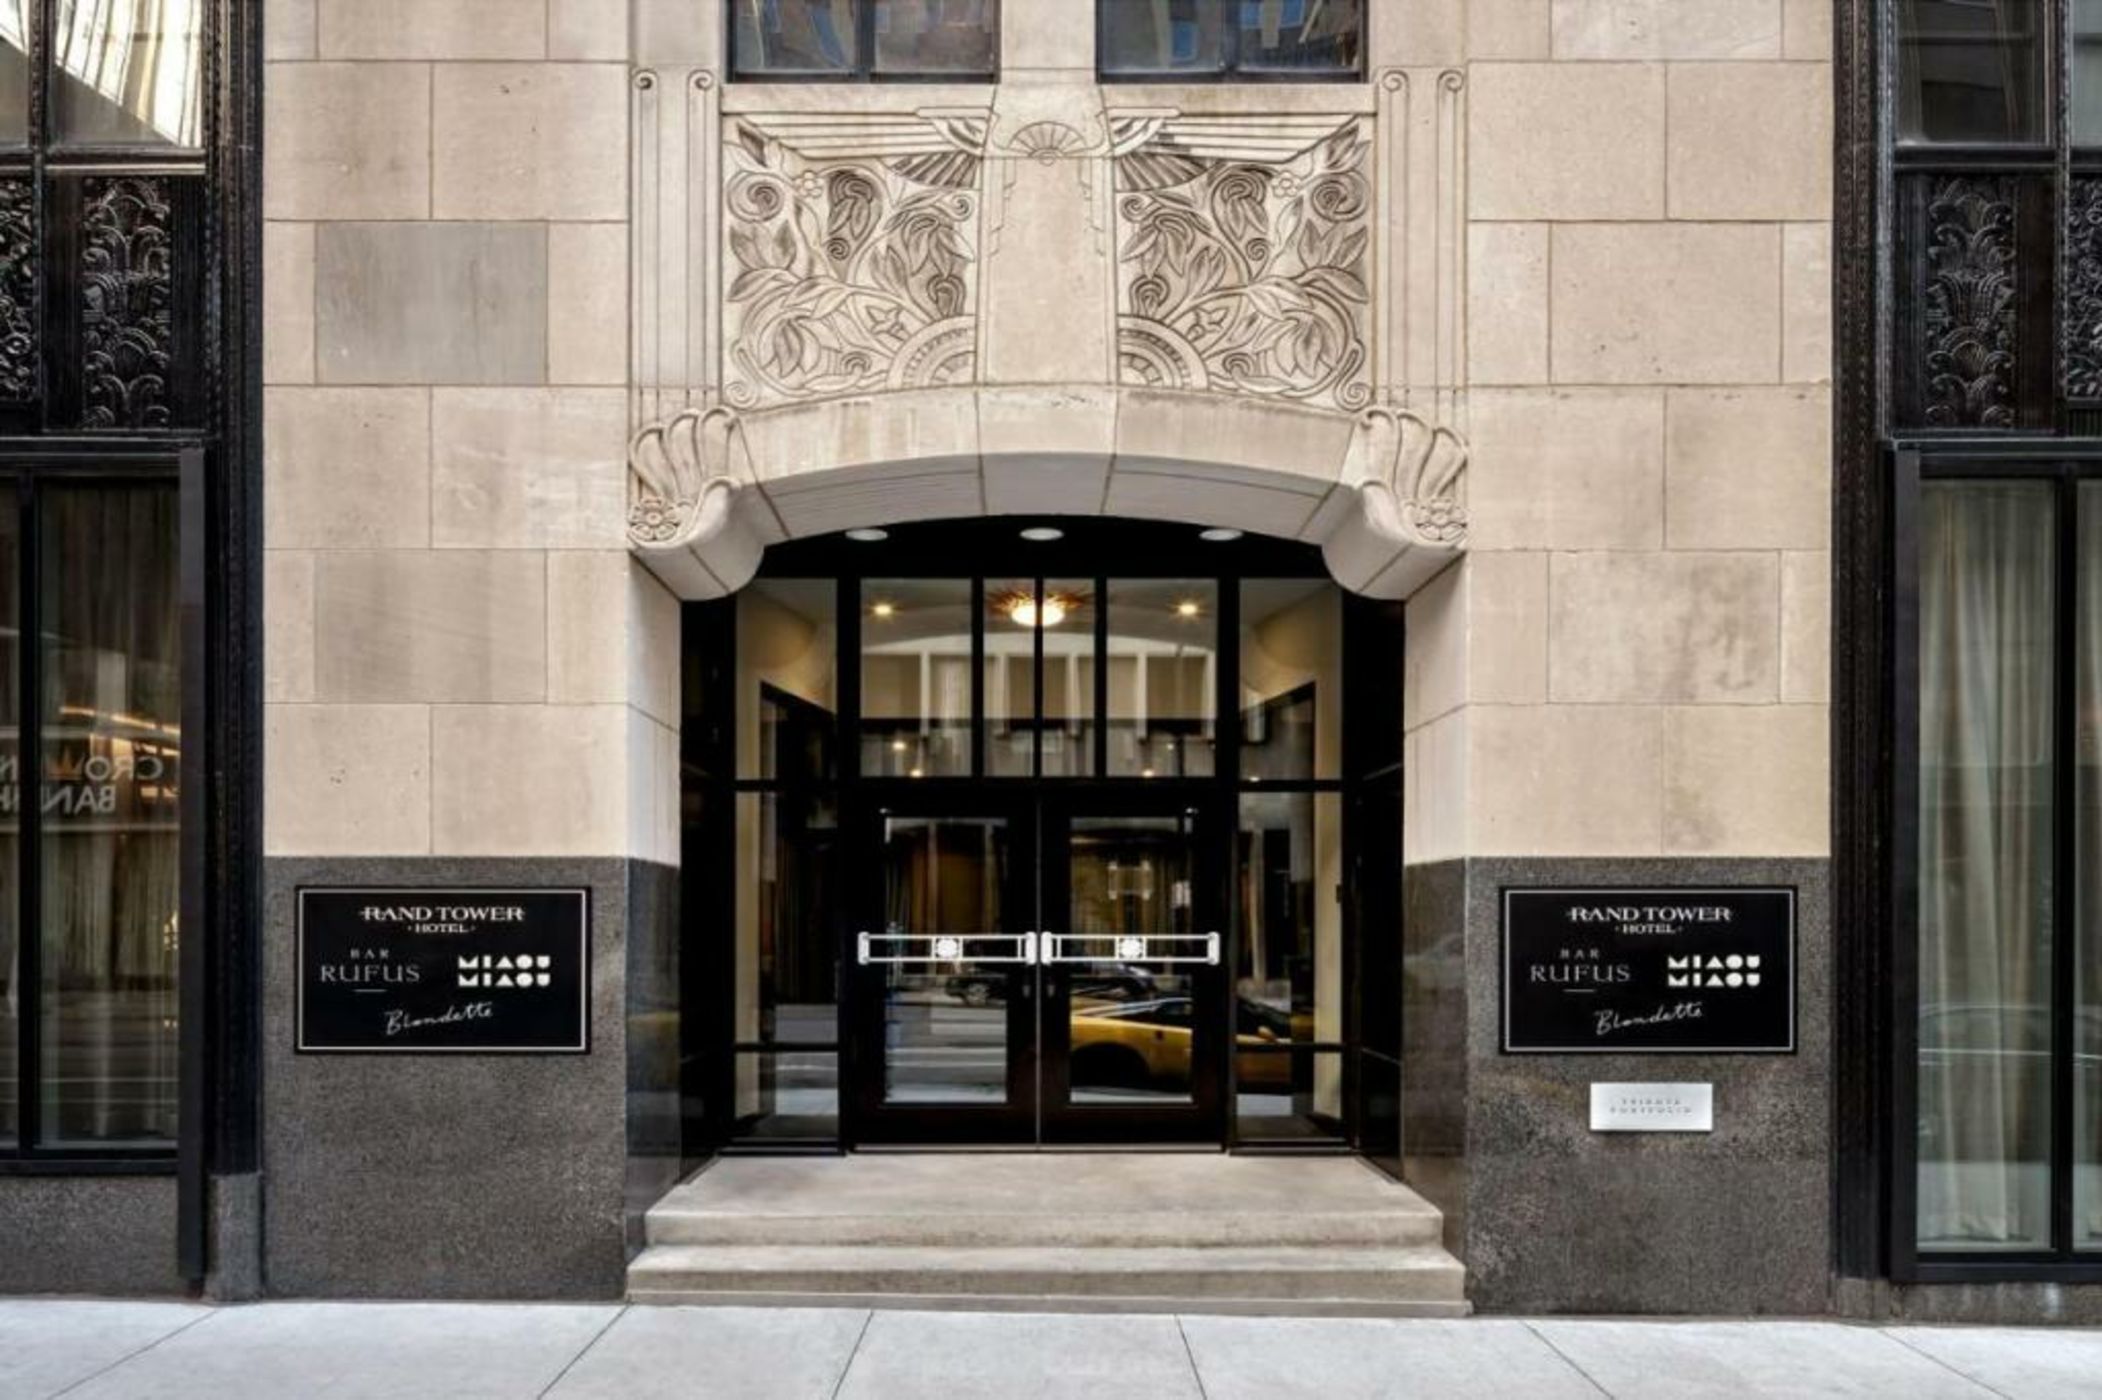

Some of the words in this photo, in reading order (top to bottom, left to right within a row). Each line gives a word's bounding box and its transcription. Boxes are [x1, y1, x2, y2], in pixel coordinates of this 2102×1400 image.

[361, 906, 432, 921] RAND
[435, 906, 524, 921] TOWER
[1568, 906, 1640, 921] RAND
[1643, 906, 1731, 921] TOWER
[415, 923, 468, 933] HOTEL
[1622, 924, 1676, 934] HOTEL
[350, 949, 389, 959] BAR
[1560, 949, 1599, 959] BAR
[458, 954, 551, 970] MIAOU
[1668, 954, 1760, 970] MIAOU
[321, 964, 420, 983] RUFUS
[458, 972, 551, 988] MIAOU
[1531, 964, 1630, 982] RUFUS
[1668, 972, 1760, 988] MIAOU
